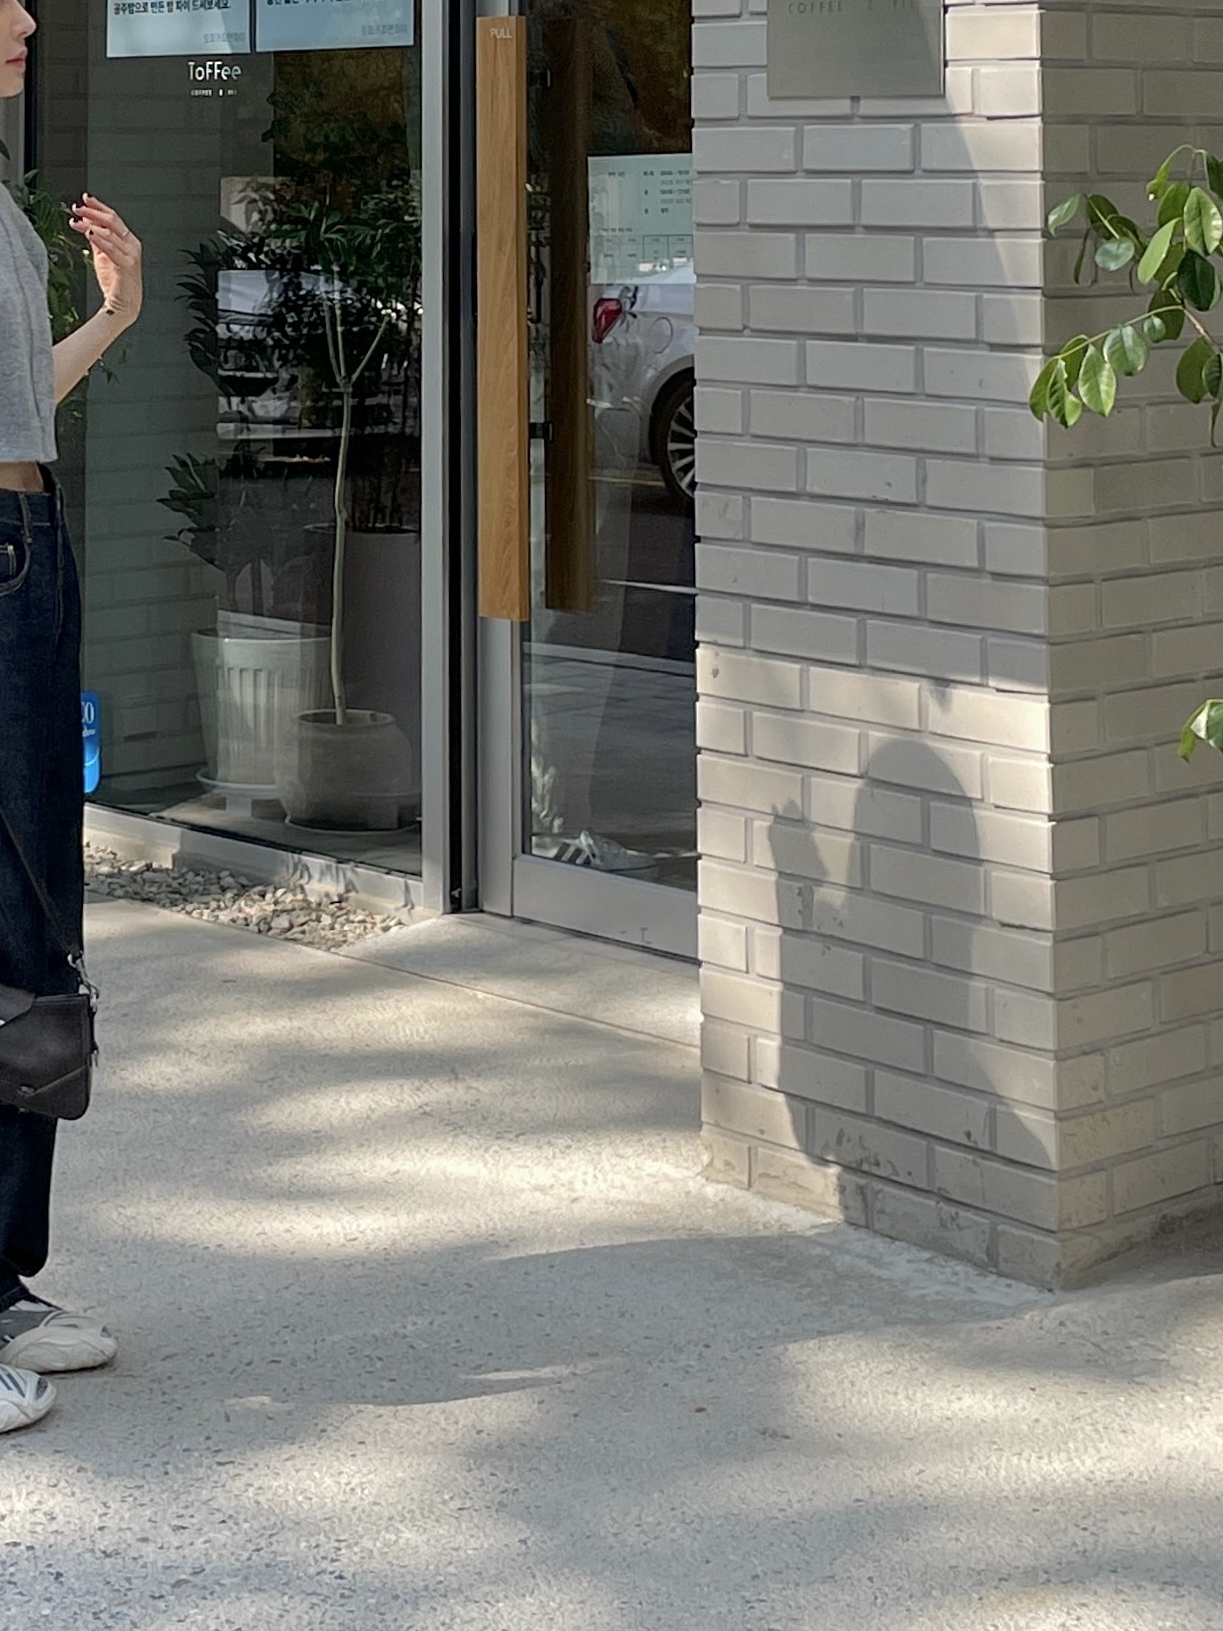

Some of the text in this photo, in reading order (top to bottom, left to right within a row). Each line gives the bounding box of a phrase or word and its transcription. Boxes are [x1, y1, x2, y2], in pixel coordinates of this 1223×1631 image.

[150, 0, 166, 15] 만든
[175, 0, 191, 13] 파이
[788, 0, 842, 14] COFFEE
[489, 27, 513, 39] PULL
[187, 61, 242, 81] ToFFee
